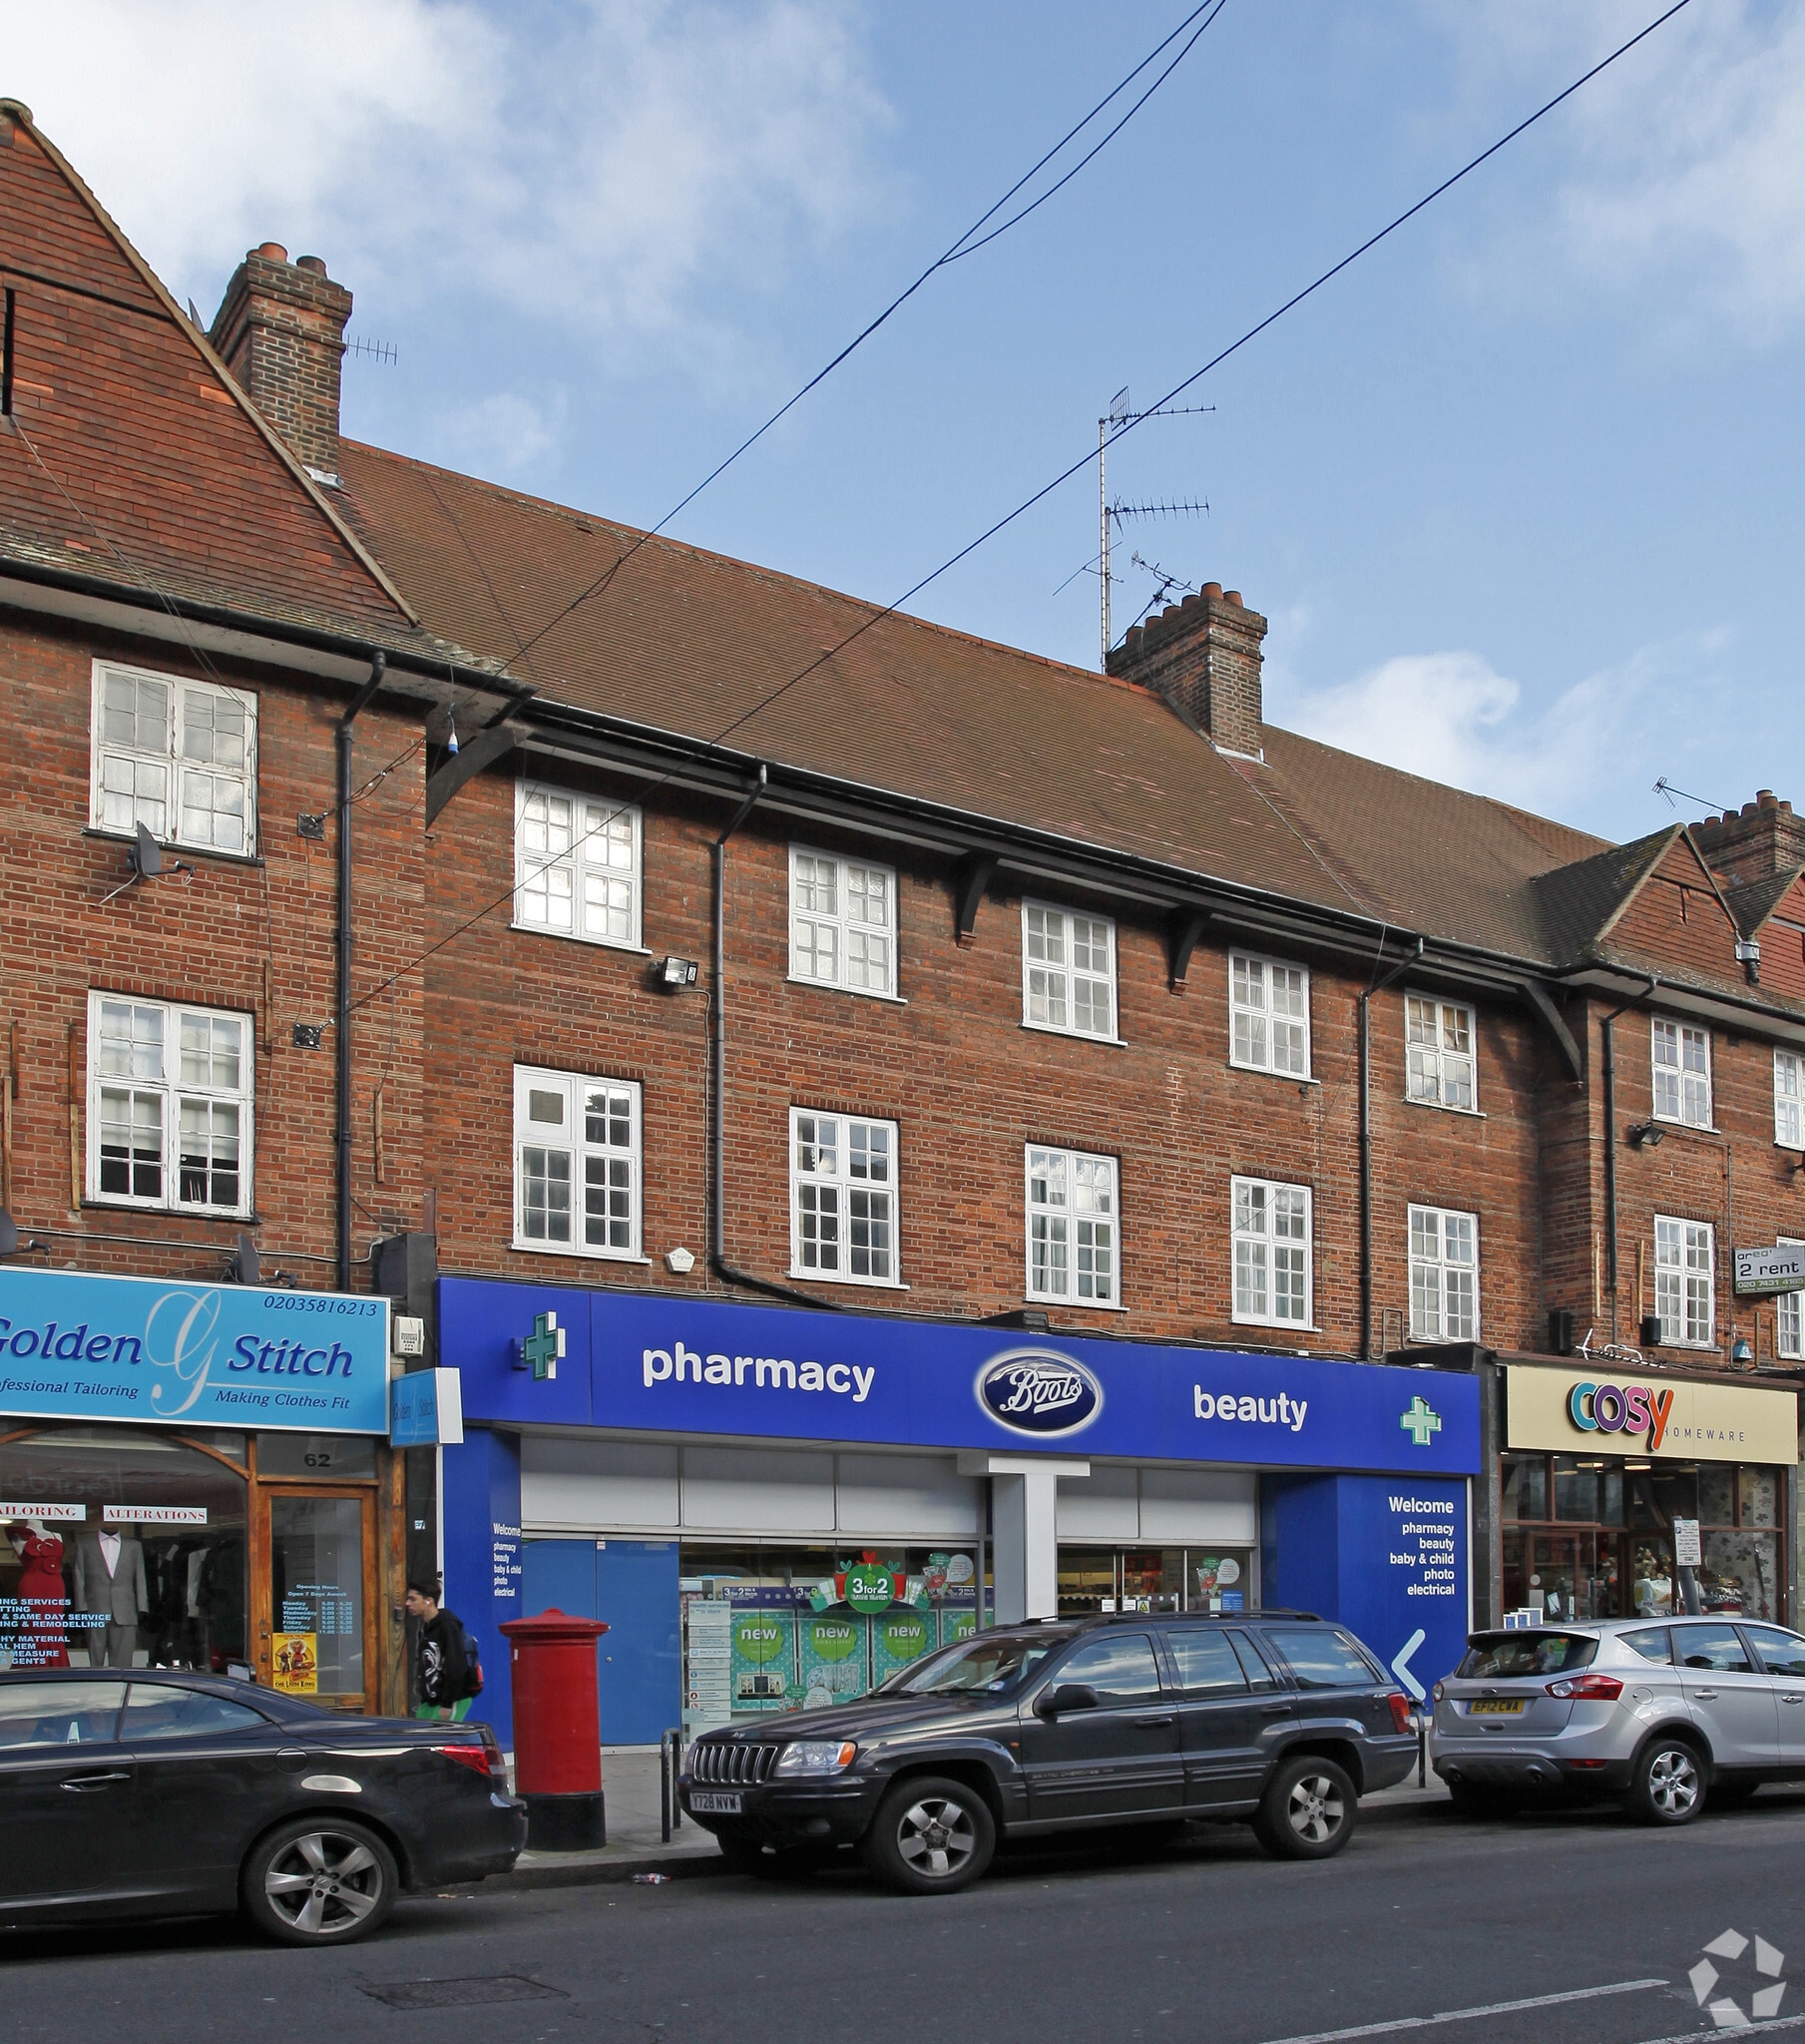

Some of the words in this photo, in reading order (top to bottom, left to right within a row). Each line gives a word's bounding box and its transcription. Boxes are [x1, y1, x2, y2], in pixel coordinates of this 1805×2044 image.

[1740, 1264, 1752, 1277] 2
[1759, 1262, 1800, 1276] rent
[263, 1295, 377, 1316] 02035816213
[226, 1333, 353, 1378] Stitch
[643, 1341, 875, 1402] pharmacy
[73, 1381, 140, 1399] Tailoring
[999, 1367, 1083, 1414] Boots
[216, 1389, 270, 1407] Making
[274, 1393, 327, 1408] Clothes
[332, 1396, 351, 1410] Fit
[1193, 1384, 1308, 1432] beauty
[304, 1453, 330, 1467] 62
[1388, 1496, 1454, 1514] Welcome
[106, 1509, 206, 1520] ALTERATIONS
[493, 1523, 521, 1537] Welcome
[1402, 1522, 1454, 1536] pharmacy
[493, 1542, 516, 1553] pharmacy
[1419, 1537, 1454, 1551] beauty
[1390, 1553, 1416, 1566] baby
[1418, 1554, 1427, 1564] &
[1429, 1553, 1454, 1565] child
[493, 1565, 505, 1575] baby
[510, 1566, 522, 1575] child
[1424, 1568, 1455, 1581] photo
[1407, 1584, 1455, 1596] electrical
[741, 1628, 777, 1640] new
[815, 1626, 851, 1639] new
[888, 1625, 921, 1638] new
[958, 1624, 977, 1637] ne
[1475, 1702, 1496, 1712] EF12
[1499, 1701, 1519, 1712] CWA
[692, 1795, 714, 1808] Y728
[716, 1796, 736, 1809] NVW
